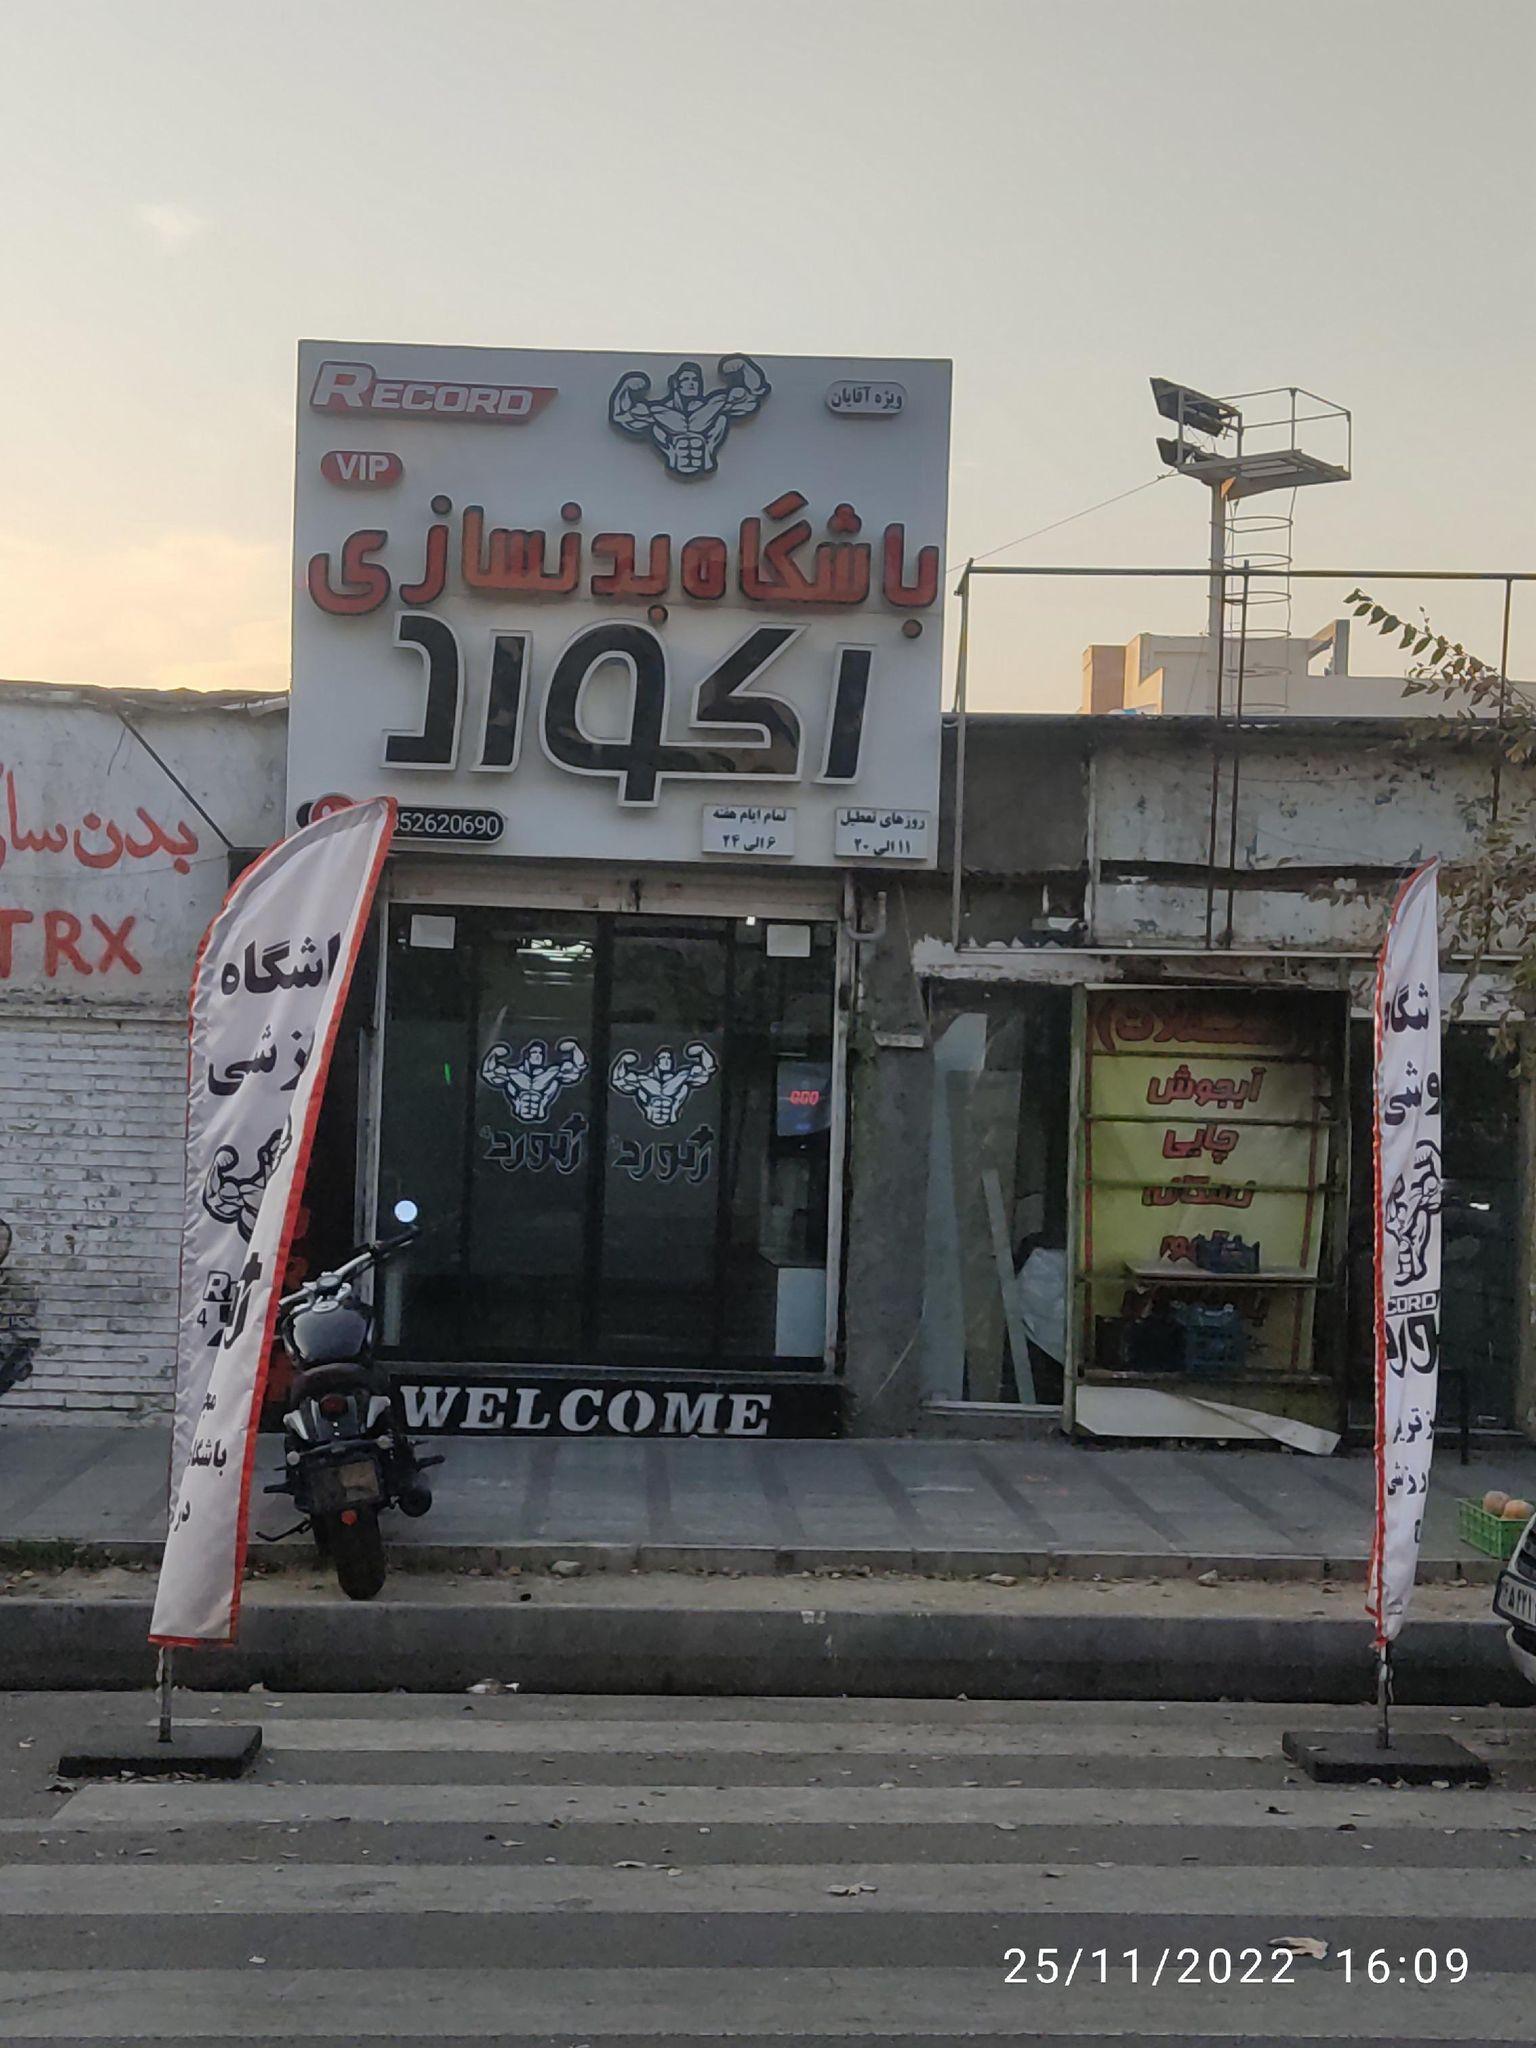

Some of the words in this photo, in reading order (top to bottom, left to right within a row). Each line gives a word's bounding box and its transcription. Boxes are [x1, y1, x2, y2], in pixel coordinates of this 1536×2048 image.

[313, 364, 533, 415] RECORD
[831, 386, 872, 407] آقایان
[335, 454, 390, 481] VIP
[681, 490, 939, 638] باشگاه
[396, 812, 500, 836] 52620690
[713, 807, 737, 820] هفته
[740, 808, 761, 824] ایام
[763, 807, 787, 824] تمام
[840, 809, 877, 827] تعطیل
[743, 836, 764, 852] الی
[873, 839, 895, 856] الی
[0, 910, 143, 978] TRX
[221, 932, 341, 996] اشگاه
[1386, 1292, 1437, 1315] CORD
[400, 1385, 772, 1435] WELCOME
